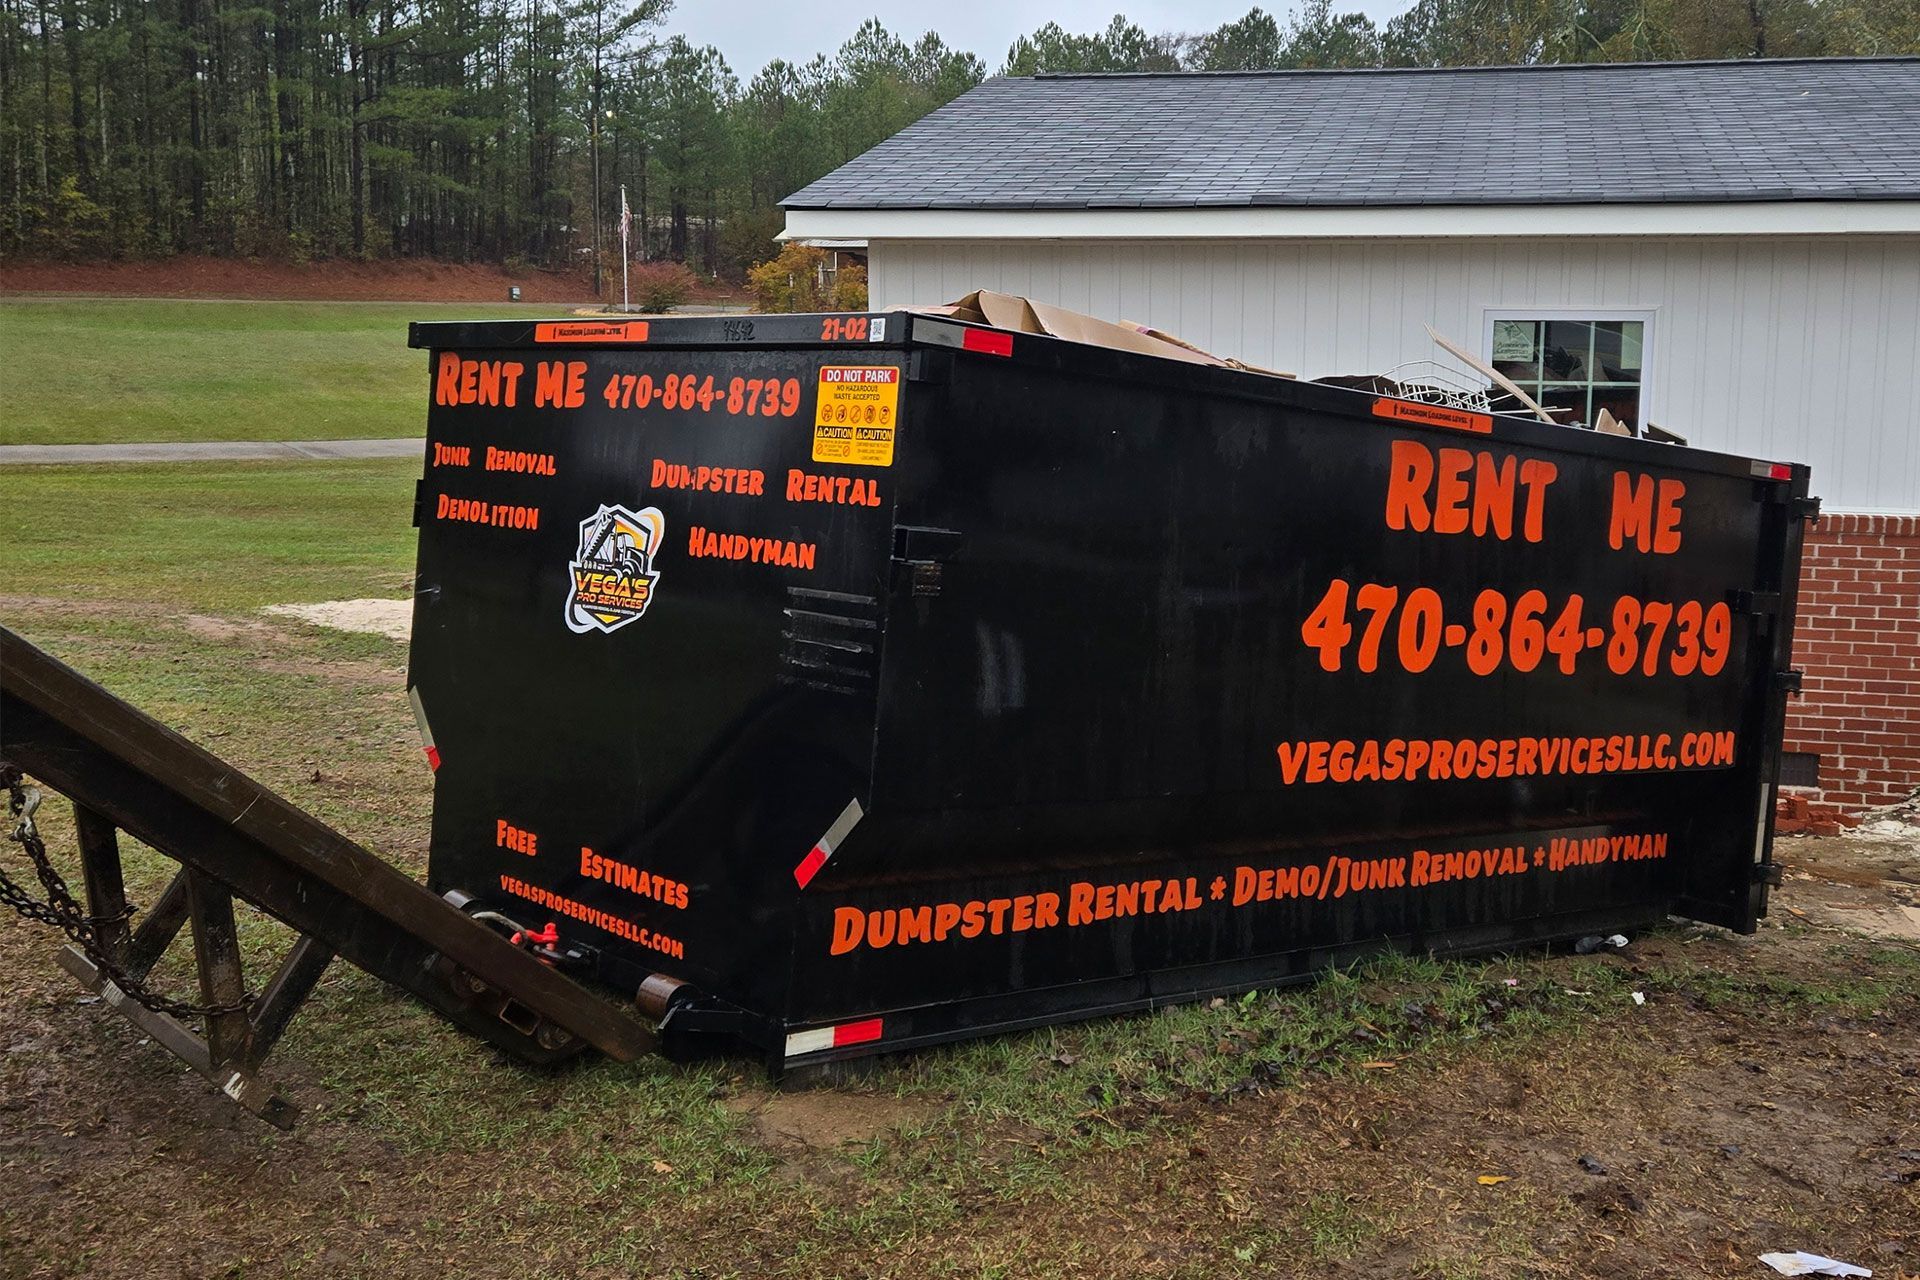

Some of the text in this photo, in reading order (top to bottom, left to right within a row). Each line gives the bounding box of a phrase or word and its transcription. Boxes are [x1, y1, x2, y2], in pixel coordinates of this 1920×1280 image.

[821, 317, 868, 341] 21-02
[435, 351, 801, 417] RENT ME 470-864-8739
[826, 369, 891, 383] DO NOT PARK
[846, 384, 878, 392] HAZARDOUS
[852, 393, 880, 401] ACCEPTED
[823, 427, 852, 440] CAUTION
[862, 428, 892, 441] CAUTION
[433, 442, 557, 476] JUNK REMOVAL
[650, 458, 882, 508] DUMPSTER RENTAL
[1385, 439, 1686, 554] RENT ME
[436, 493, 539, 530] DEMOLITION
[688, 526, 816, 570] HANDYMAN
[575, 571, 650, 600] VEGA'S
[576, 592, 597, 603] PRO
[598, 594, 643, 610] SERVICES
[1301, 578, 1731, 677] 470-864-8739
[1276, 731, 1736, 785] VEGASPROSERVICESLLC.COM
[496, 819, 689, 910] FREE ESTIMATES
[830, 834, 1668, 956] DUMPSTER RENTAL DEMO/JUNK REMOVAL HANDYMAN
[500, 874, 684, 960] VEGASPROSERVICESLLC.COM
